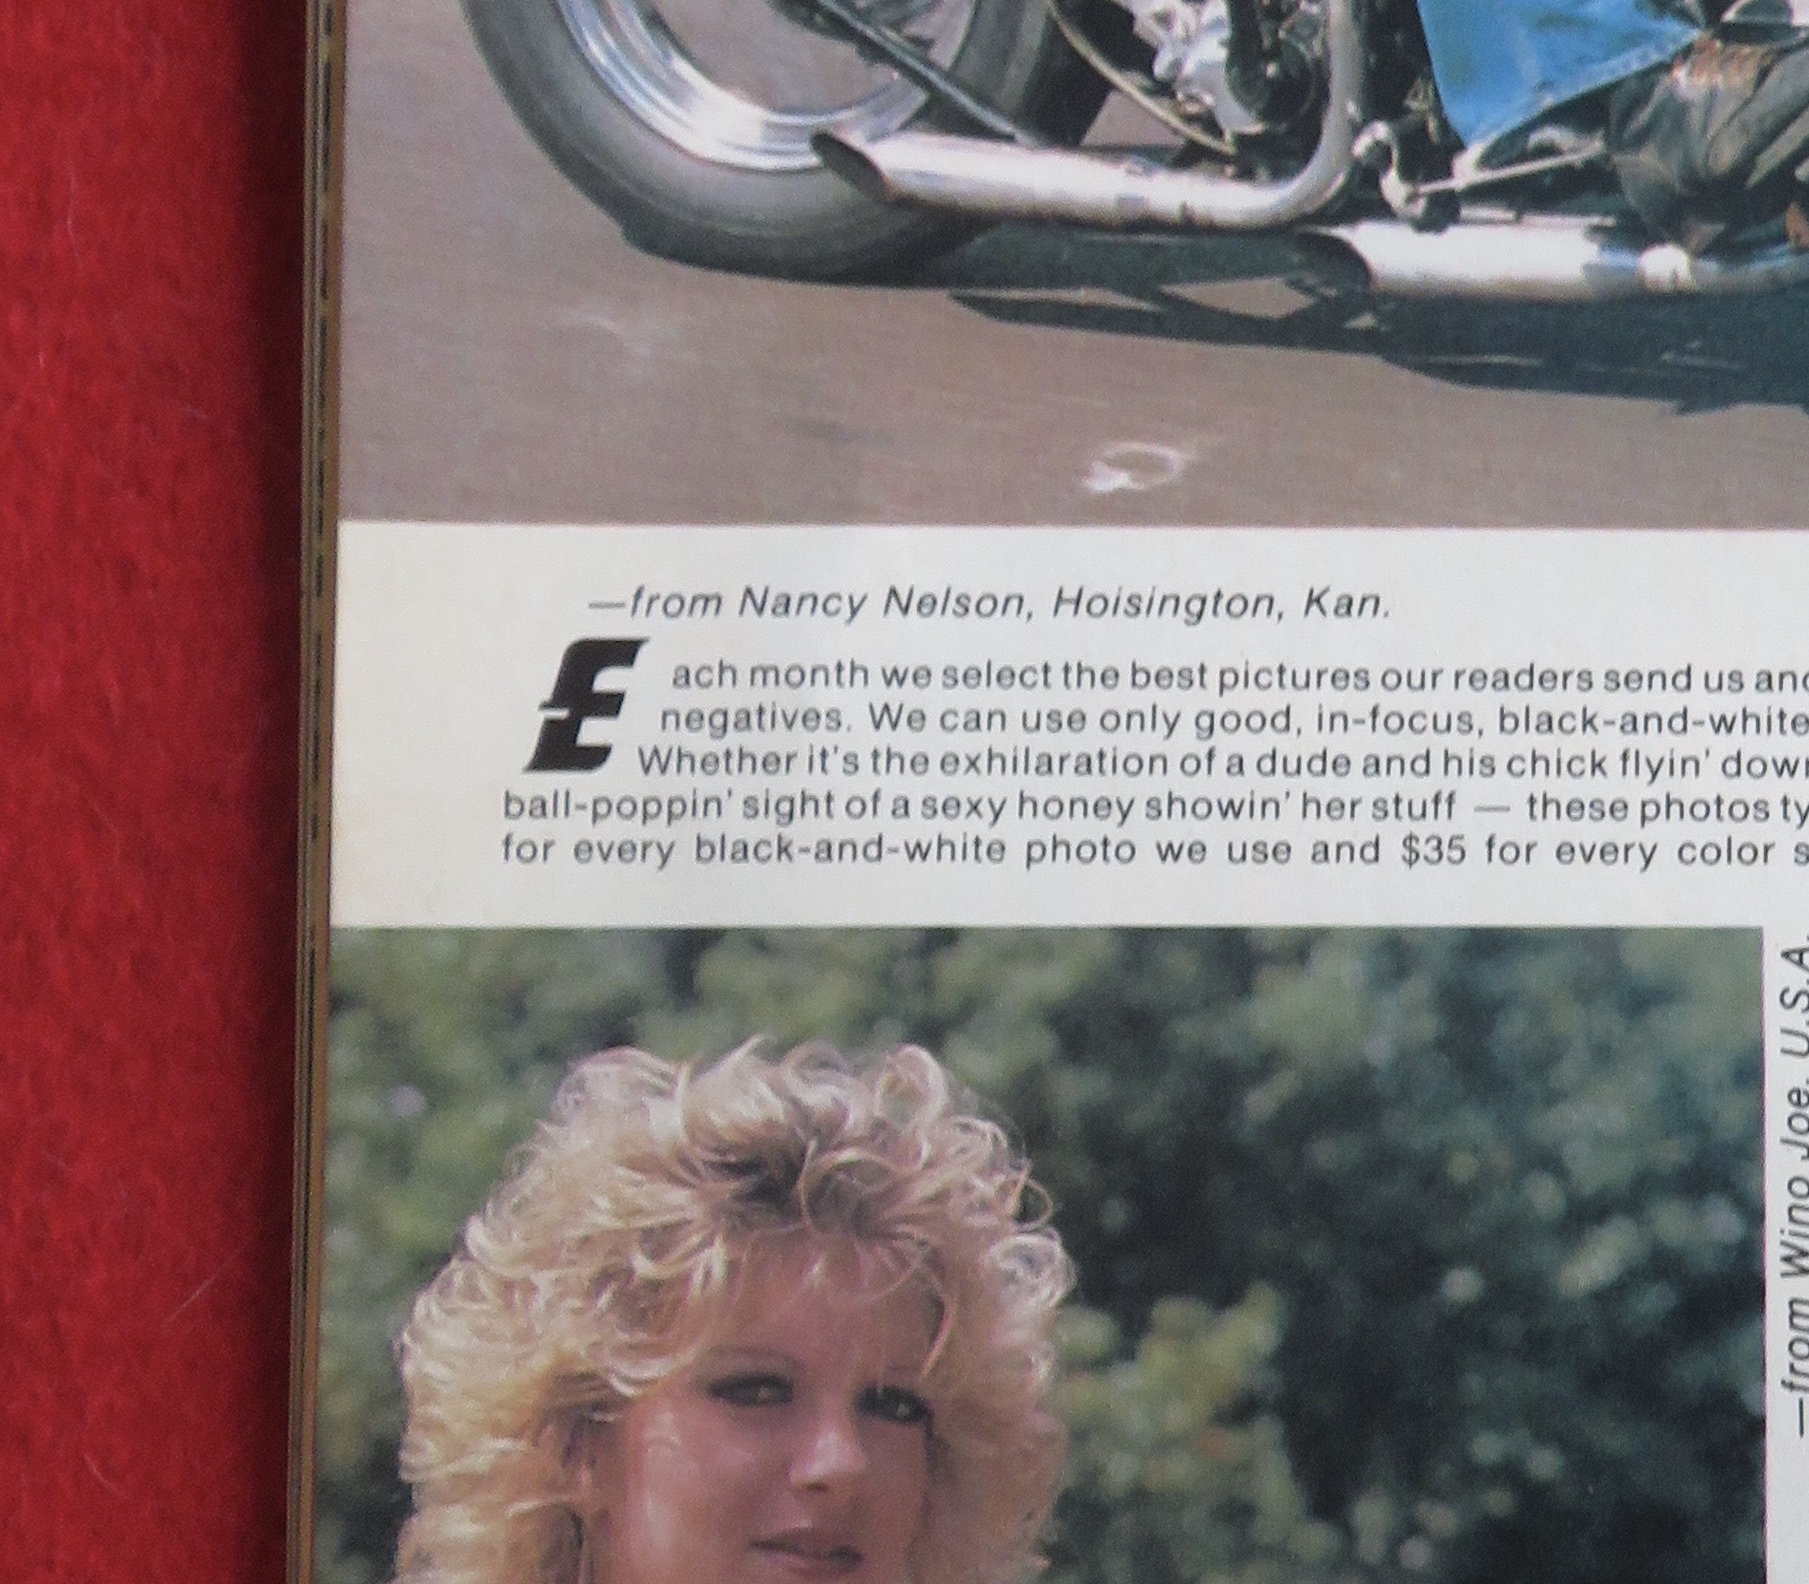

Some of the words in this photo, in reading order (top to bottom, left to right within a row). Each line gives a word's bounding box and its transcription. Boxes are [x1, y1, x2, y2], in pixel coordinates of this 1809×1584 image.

[738, 585, 868, 624] Nancy
[883, 585, 1033, 622] Nelson,
[1052, 586, 1284, 627] Hoisington,
[1303, 586, 1389, 618] Kan.
[749, 658, 869, 690] month
[881, 665, 933, 689] we
[942, 659, 1052, 690] select
[1062, 660, 1121, 690] the
[1130, 660, 1208, 691] best
[1218, 660, 1371, 698] pictures
[1380, 668, 1444, 692] our
[1453, 662, 1594, 693] readers
[1603, 663, 1692, 693] send
[1703, 669, 1745, 694] us
[661, 701, 851, 740] negatives.
[868, 701, 927, 733] We
[939, 709, 1007, 733] can
[1021, 709, 1087, 734] use
[1099, 702, 1182, 741] only
[1194, 703, 1302, 741] good,
[1317, 703, 1484, 738] in-focus,
[637, 744, 798, 777] Whether
[807, 744, 860, 776] it's
[871, 745, 930, 776] the
[939, 745, 1168, 778] exhilaration
[1179, 745, 1216, 778] of
[1225, 753, 1245, 777] a
[1255, 746, 1352, 778] dude
[1361, 747, 1431, 778] and
[1443, 747, 1497, 778] his
[1506, 747, 1608, 779] chick
[1619, 747, 1710, 786] flyin'
[503, 788, 733, 827] ball-poppin'
[742, 788, 835, 828] sight
[844, 787, 881, 820] of
[890, 795, 911, 820] a
[921, 795, 1007, 828] sexy
[1018, 789, 1135, 828] honey
[1145, 789, 1291, 821] showin'
[1301, 790, 1362, 821] her
[1371, 789, 1456, 822] stuff
[1527, 791, 1629, 822] these
[1639, 791, 1771, 829] photos
[502, 832, 555, 864] for
[573, 839, 676, 871] every
[695, 832, 1007, 864] black-and-white
[1025, 833, 1137, 871] photo
[1155, 840, 1208, 865] we
[1227, 840, 1292, 865] use
[1310, 833, 1381, 865] and
[1401, 831, 1467, 870] $35
[1485, 833, 1538, 866] for
[1555, 841, 1658, 873] every
[1677, 835, 1776, 866] color
